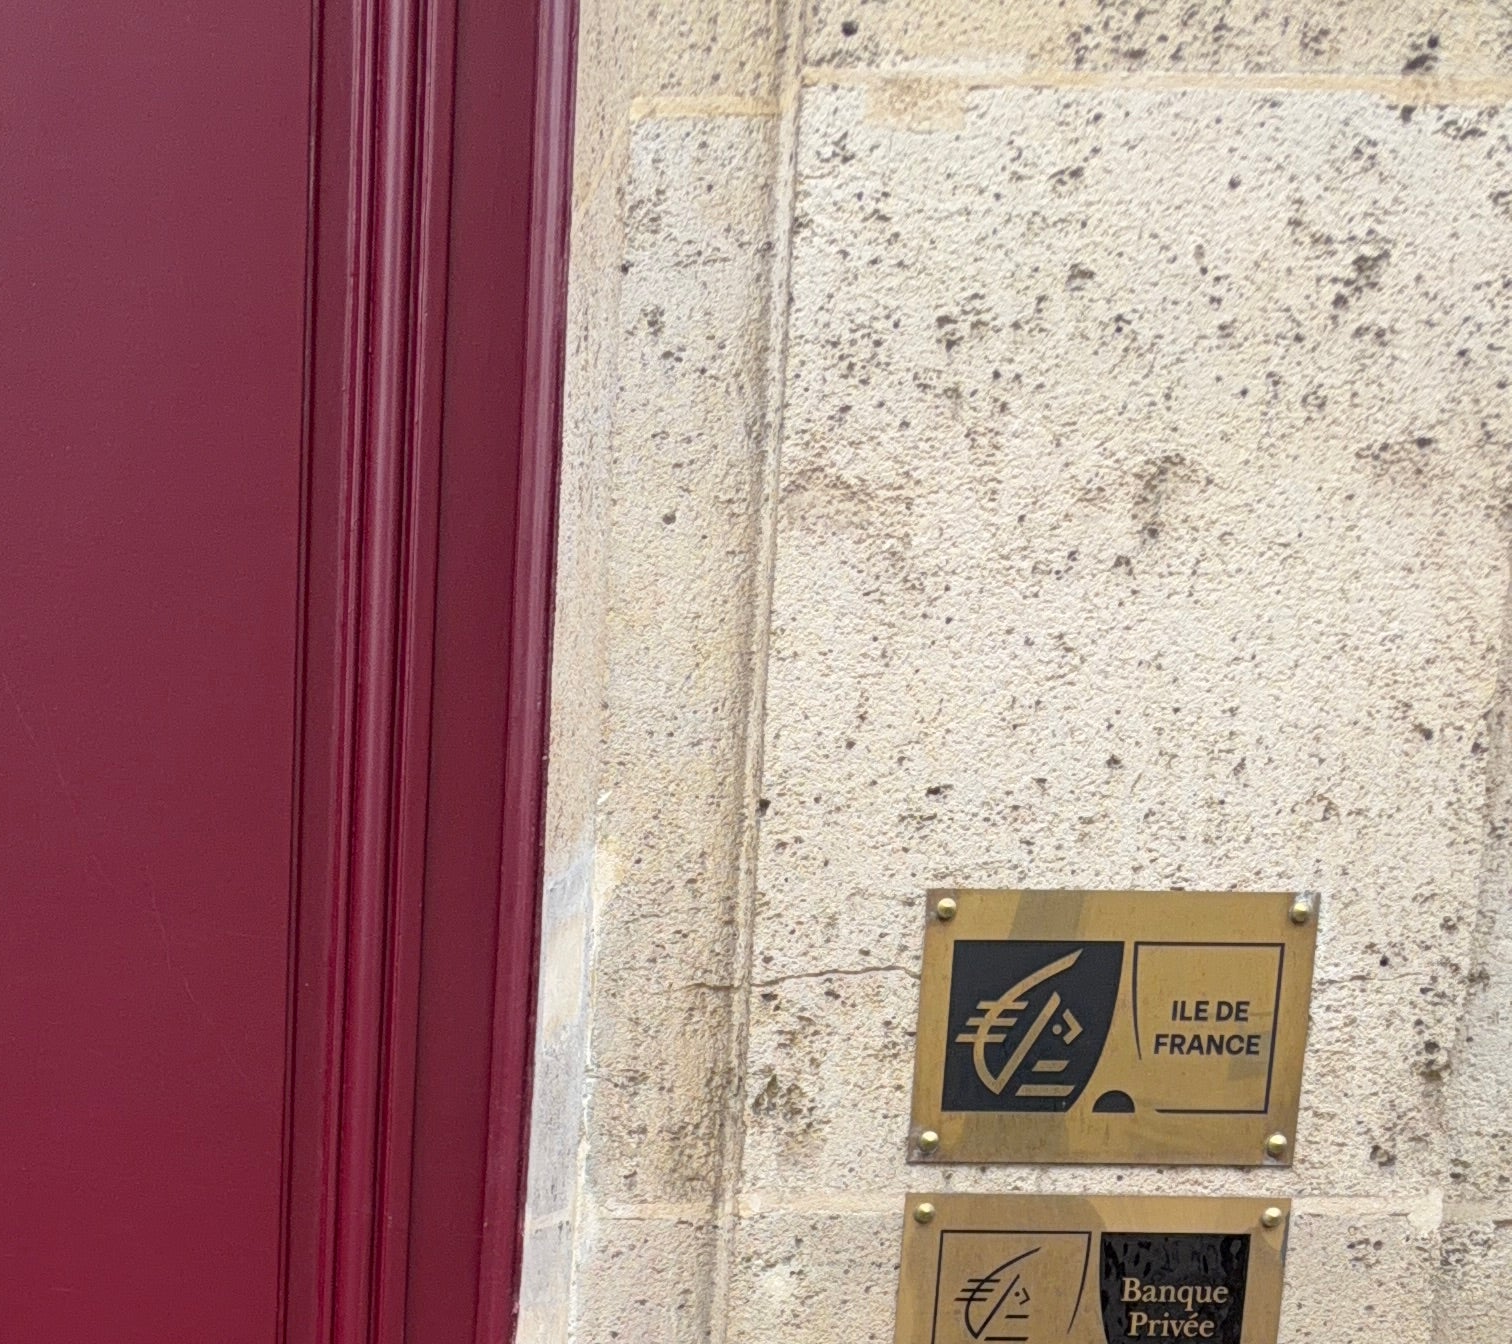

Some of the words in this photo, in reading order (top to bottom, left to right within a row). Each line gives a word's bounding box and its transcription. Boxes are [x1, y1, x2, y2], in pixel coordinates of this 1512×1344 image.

[1170, 1000, 1209, 1022] ILE
[1215, 1001, 1250, 1023] DE
[1153, 1033, 1261, 1056] FRANCE
[1120, 1277, 1229, 1312] Banque
[1127, 1311, 1215, 1338] Privée
